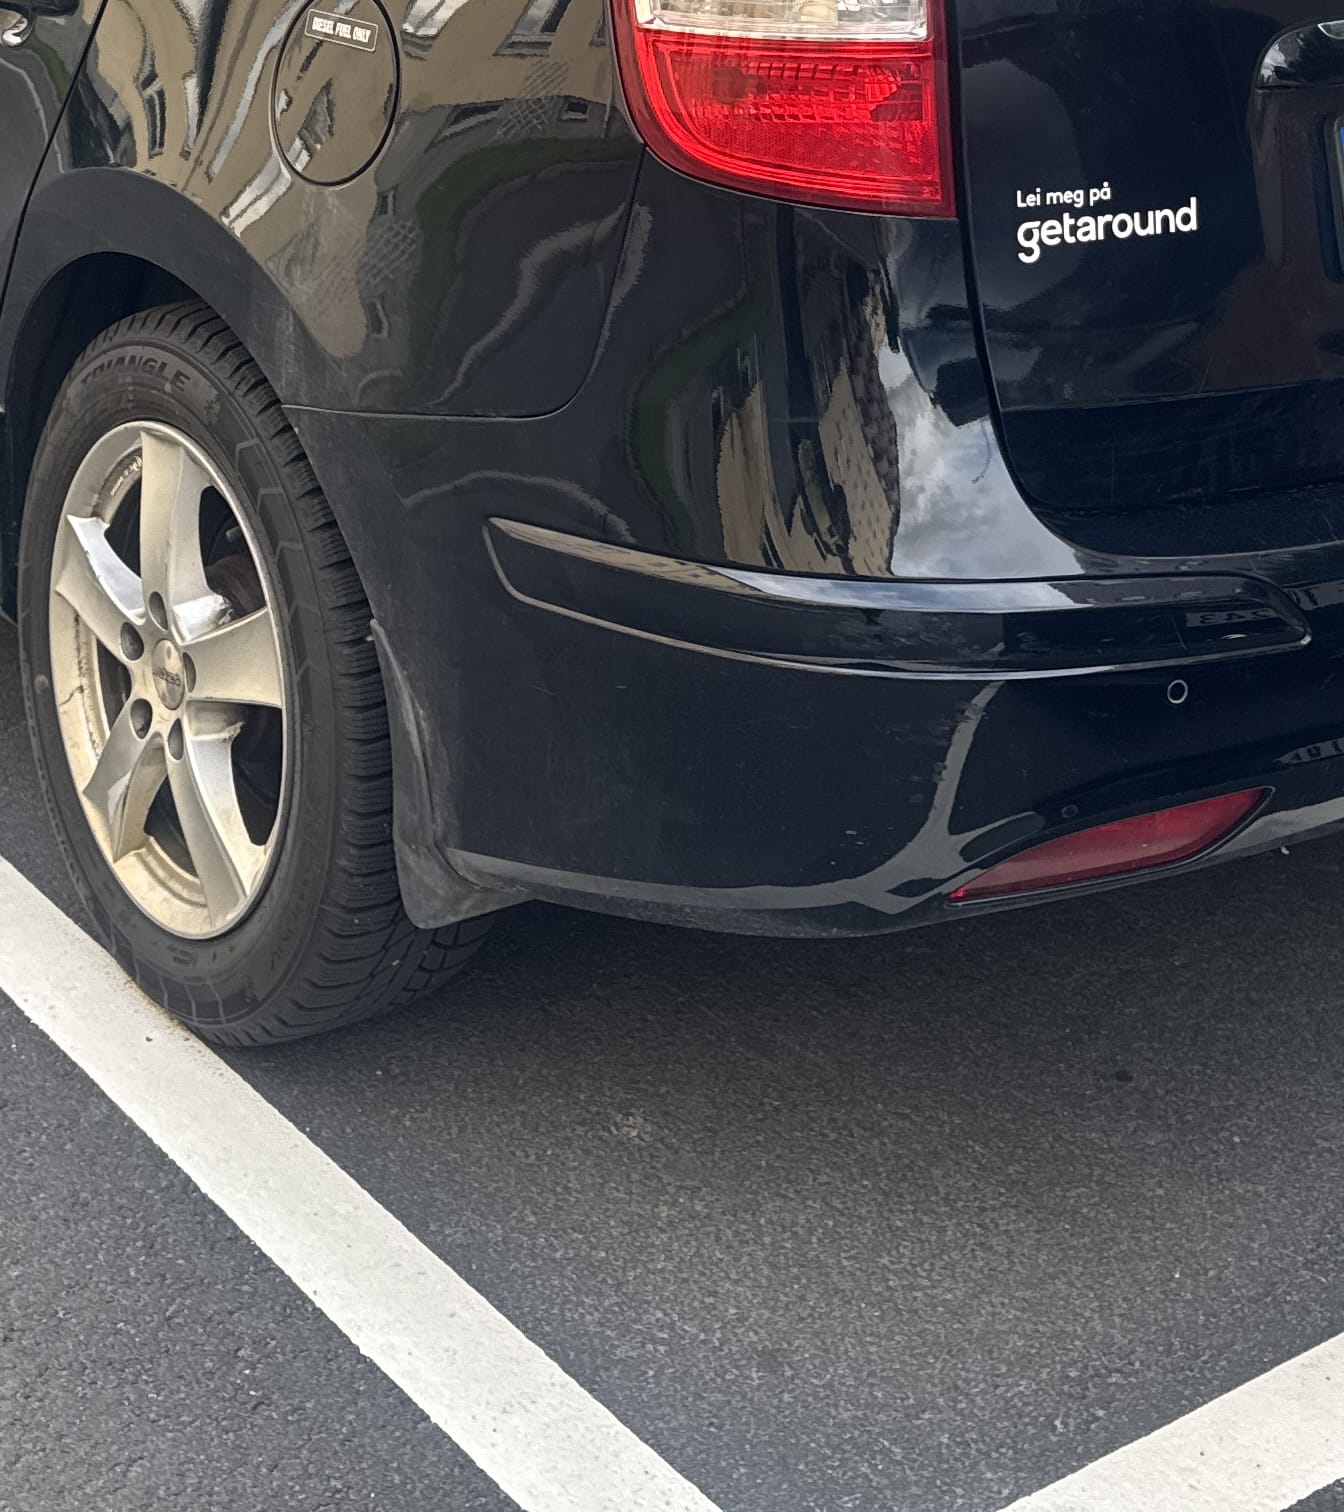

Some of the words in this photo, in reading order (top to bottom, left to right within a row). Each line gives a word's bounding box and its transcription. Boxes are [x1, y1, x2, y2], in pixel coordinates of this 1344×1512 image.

[335, 22, 353, 39] FUEL
[352, 26, 372, 43] ONLY
[1016, 187, 1041, 208] Lei
[1045, 190, 1085, 208] meg
[1089, 181, 1112, 207] på
[1016, 196, 1199, 264] getaround
[80, 354, 191, 391] TRIANGLE
